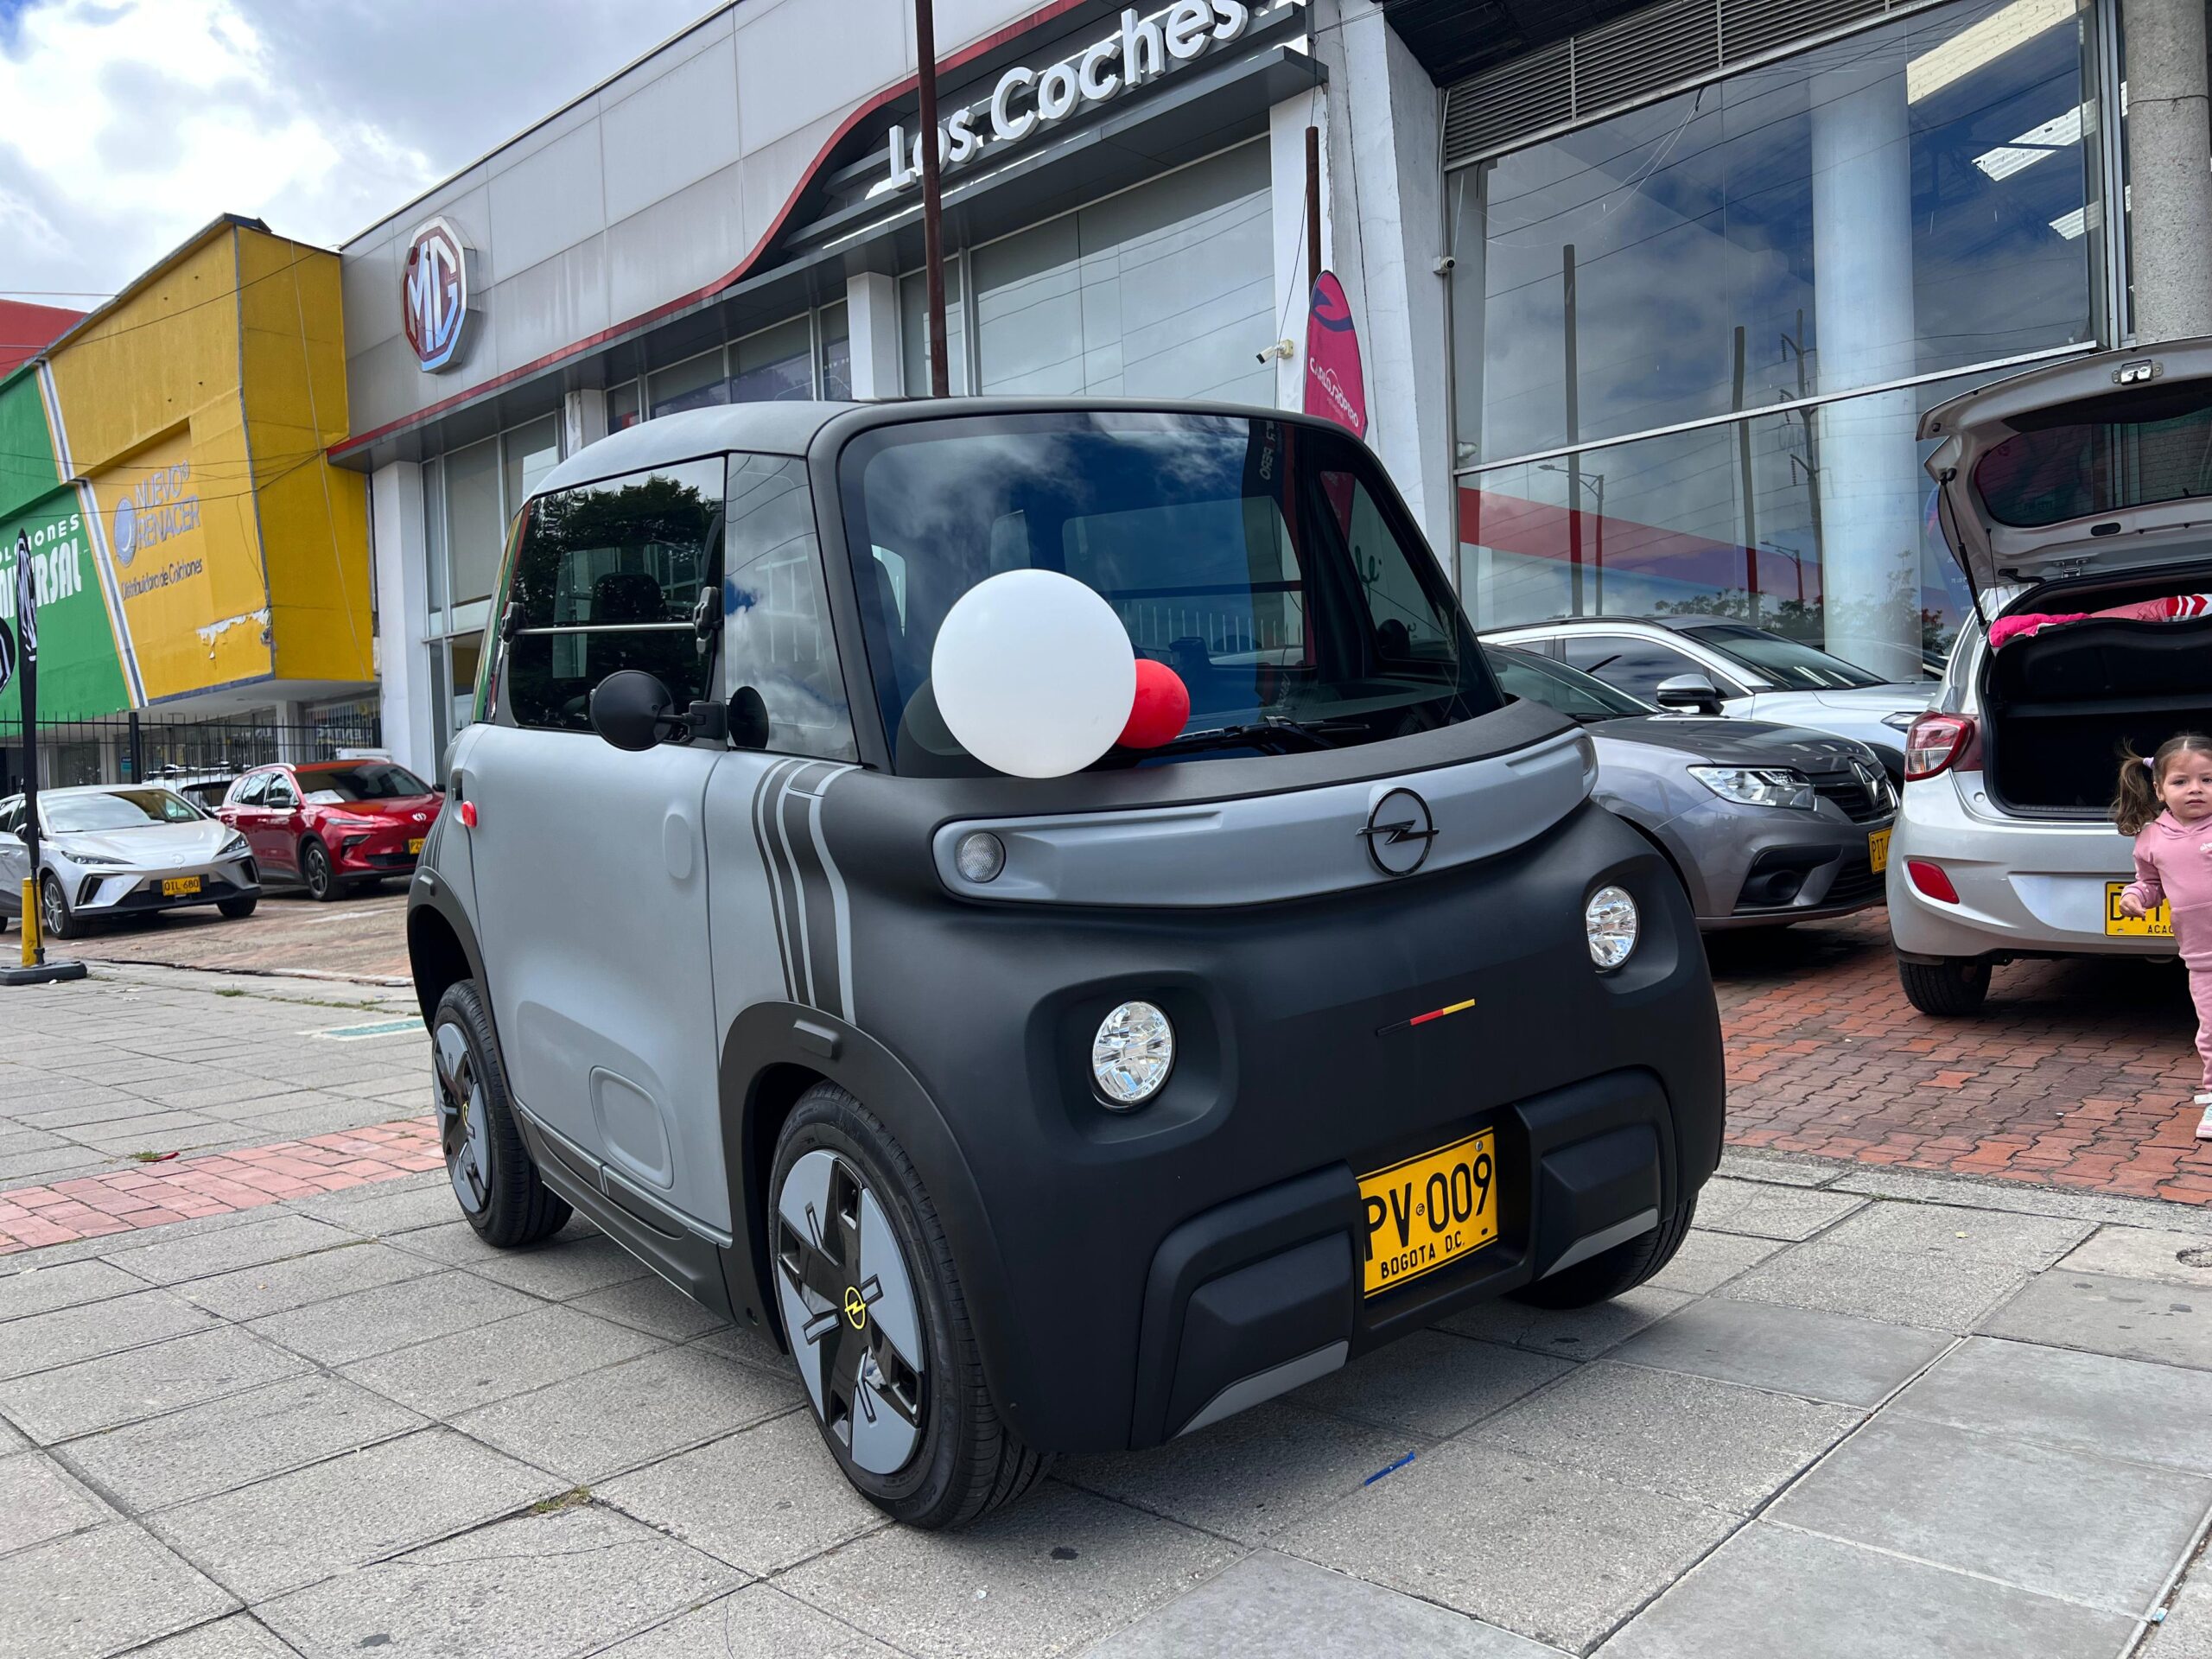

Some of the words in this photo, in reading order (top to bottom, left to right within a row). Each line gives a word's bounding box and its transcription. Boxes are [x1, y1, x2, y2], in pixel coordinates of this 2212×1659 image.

[991, 0, 1248, 142] Coches
[407, 235, 459, 353] MG
[137, 494, 200, 550] RENACER
[1381, 1243, 1436, 1280] BOGOTA
